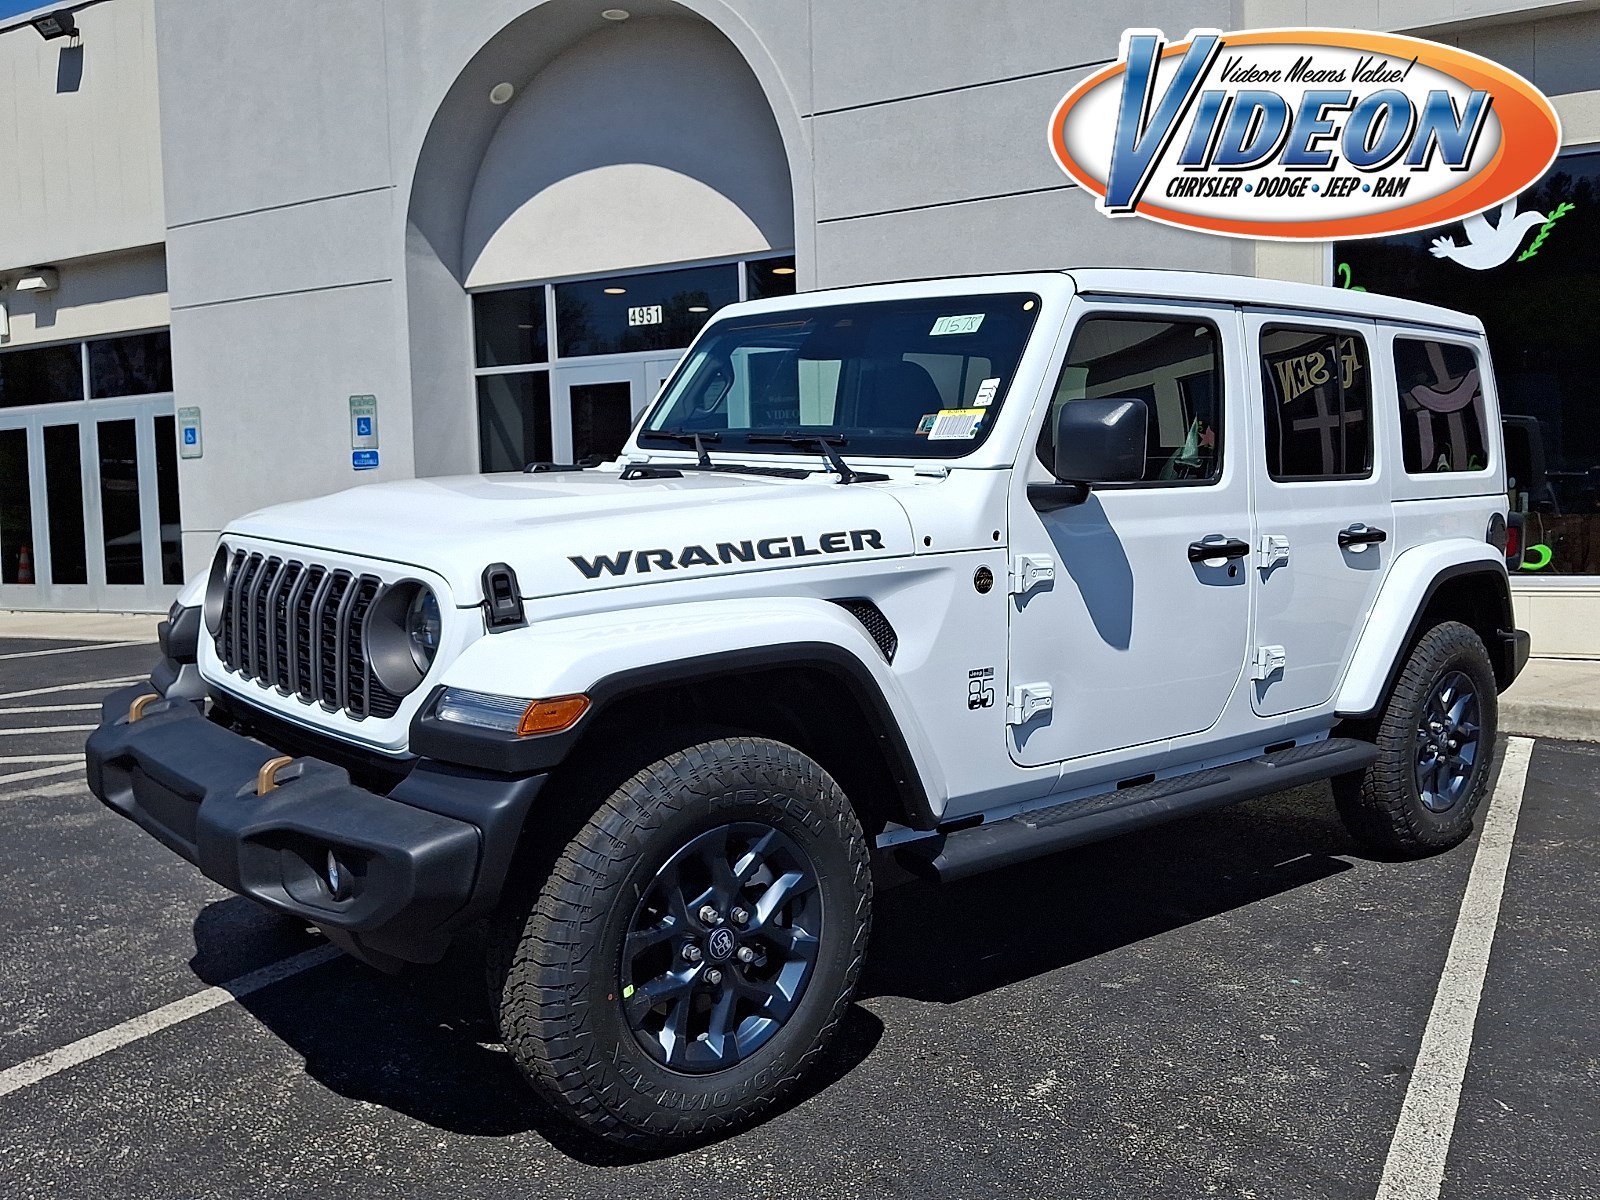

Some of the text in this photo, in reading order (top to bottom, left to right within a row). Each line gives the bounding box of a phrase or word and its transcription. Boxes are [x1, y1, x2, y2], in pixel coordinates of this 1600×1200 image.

[630, 307, 660, 324] 4951
[567, 528, 885, 579] WRANGLER
[968, 678, 994, 710] 85
[709, 789, 826, 838] NEXEN
